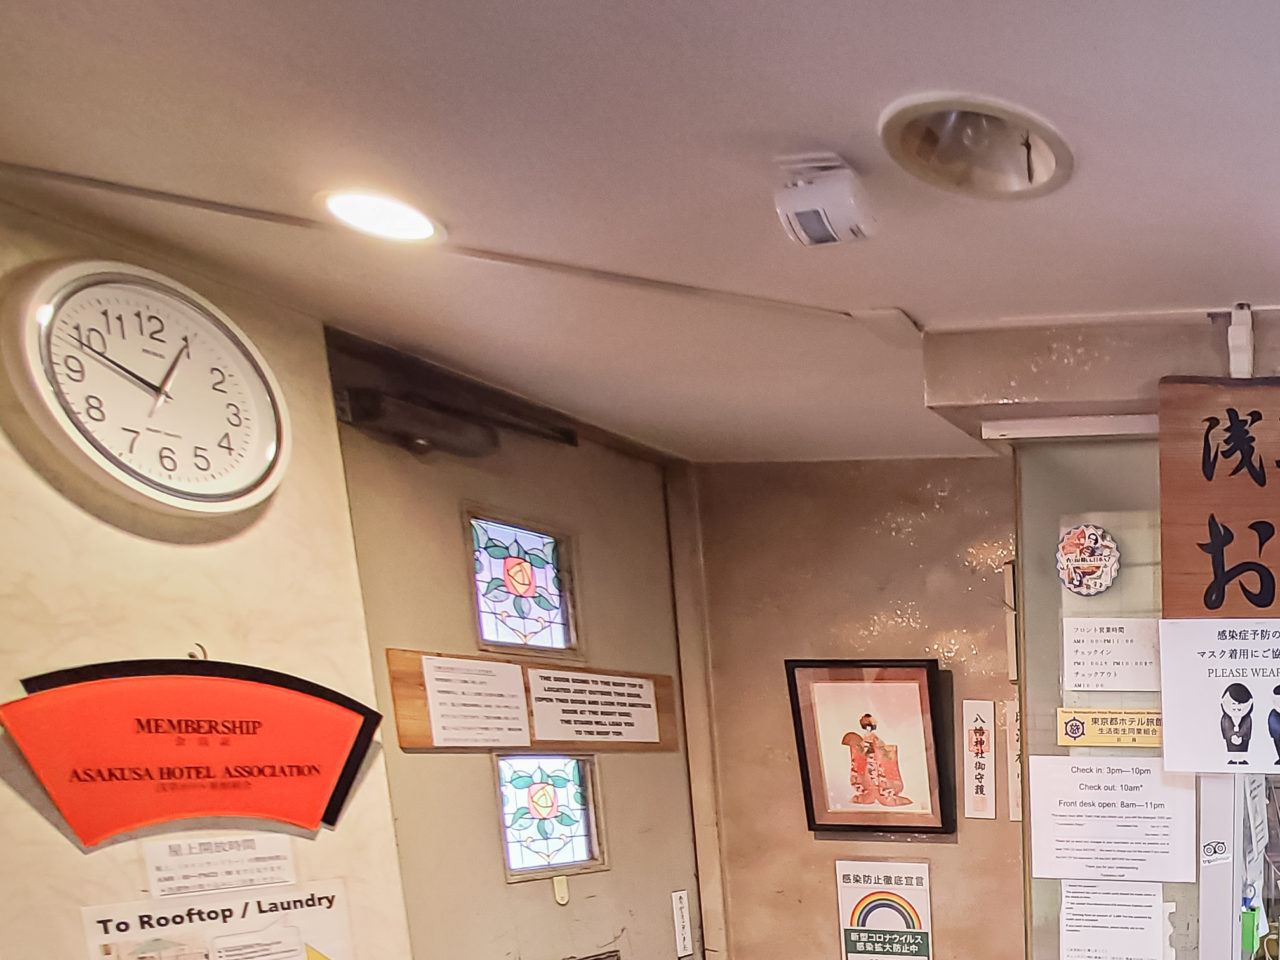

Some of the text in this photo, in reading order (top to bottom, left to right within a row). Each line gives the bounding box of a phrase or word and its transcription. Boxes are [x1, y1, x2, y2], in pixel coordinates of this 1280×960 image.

[101, 309, 126, 340] 11
[134, 310, 167, 343] 12
[72, 323, 107, 355] 10
[181, 336, 191, 360] 1
[64, 355, 85, 383] 9
[210, 367, 228, 394] 2
[85, 395, 106, 422] 8
[226, 403, 243, 428] 3
[121, 427, 141, 454] 7
[217, 432, 235, 456] 4
[159, 447, 178, 472] 6
[193, 446, 211, 471] 5
[1207, 668, 1248, 678] PLEASE
[134, 718, 262, 735] MEMBERSHIP
[69, 764, 322, 783] ASAKUSA HOTEL ASSOCIATION
[1071, 766, 1093, 775] Check
[1079, 783, 1102, 792] Check
[1058, 800, 1078, 808] Front
[1079, 800, 1097, 808] desk
[842, 874, 924, 886] 感染防止徹底宣言
[97, 893, 336, 935] To Rooftop / Laundry
[850, 932, 923, 944] 新型コロナウイルス
[856, 942, 919, 953] 感染拡大防止中
